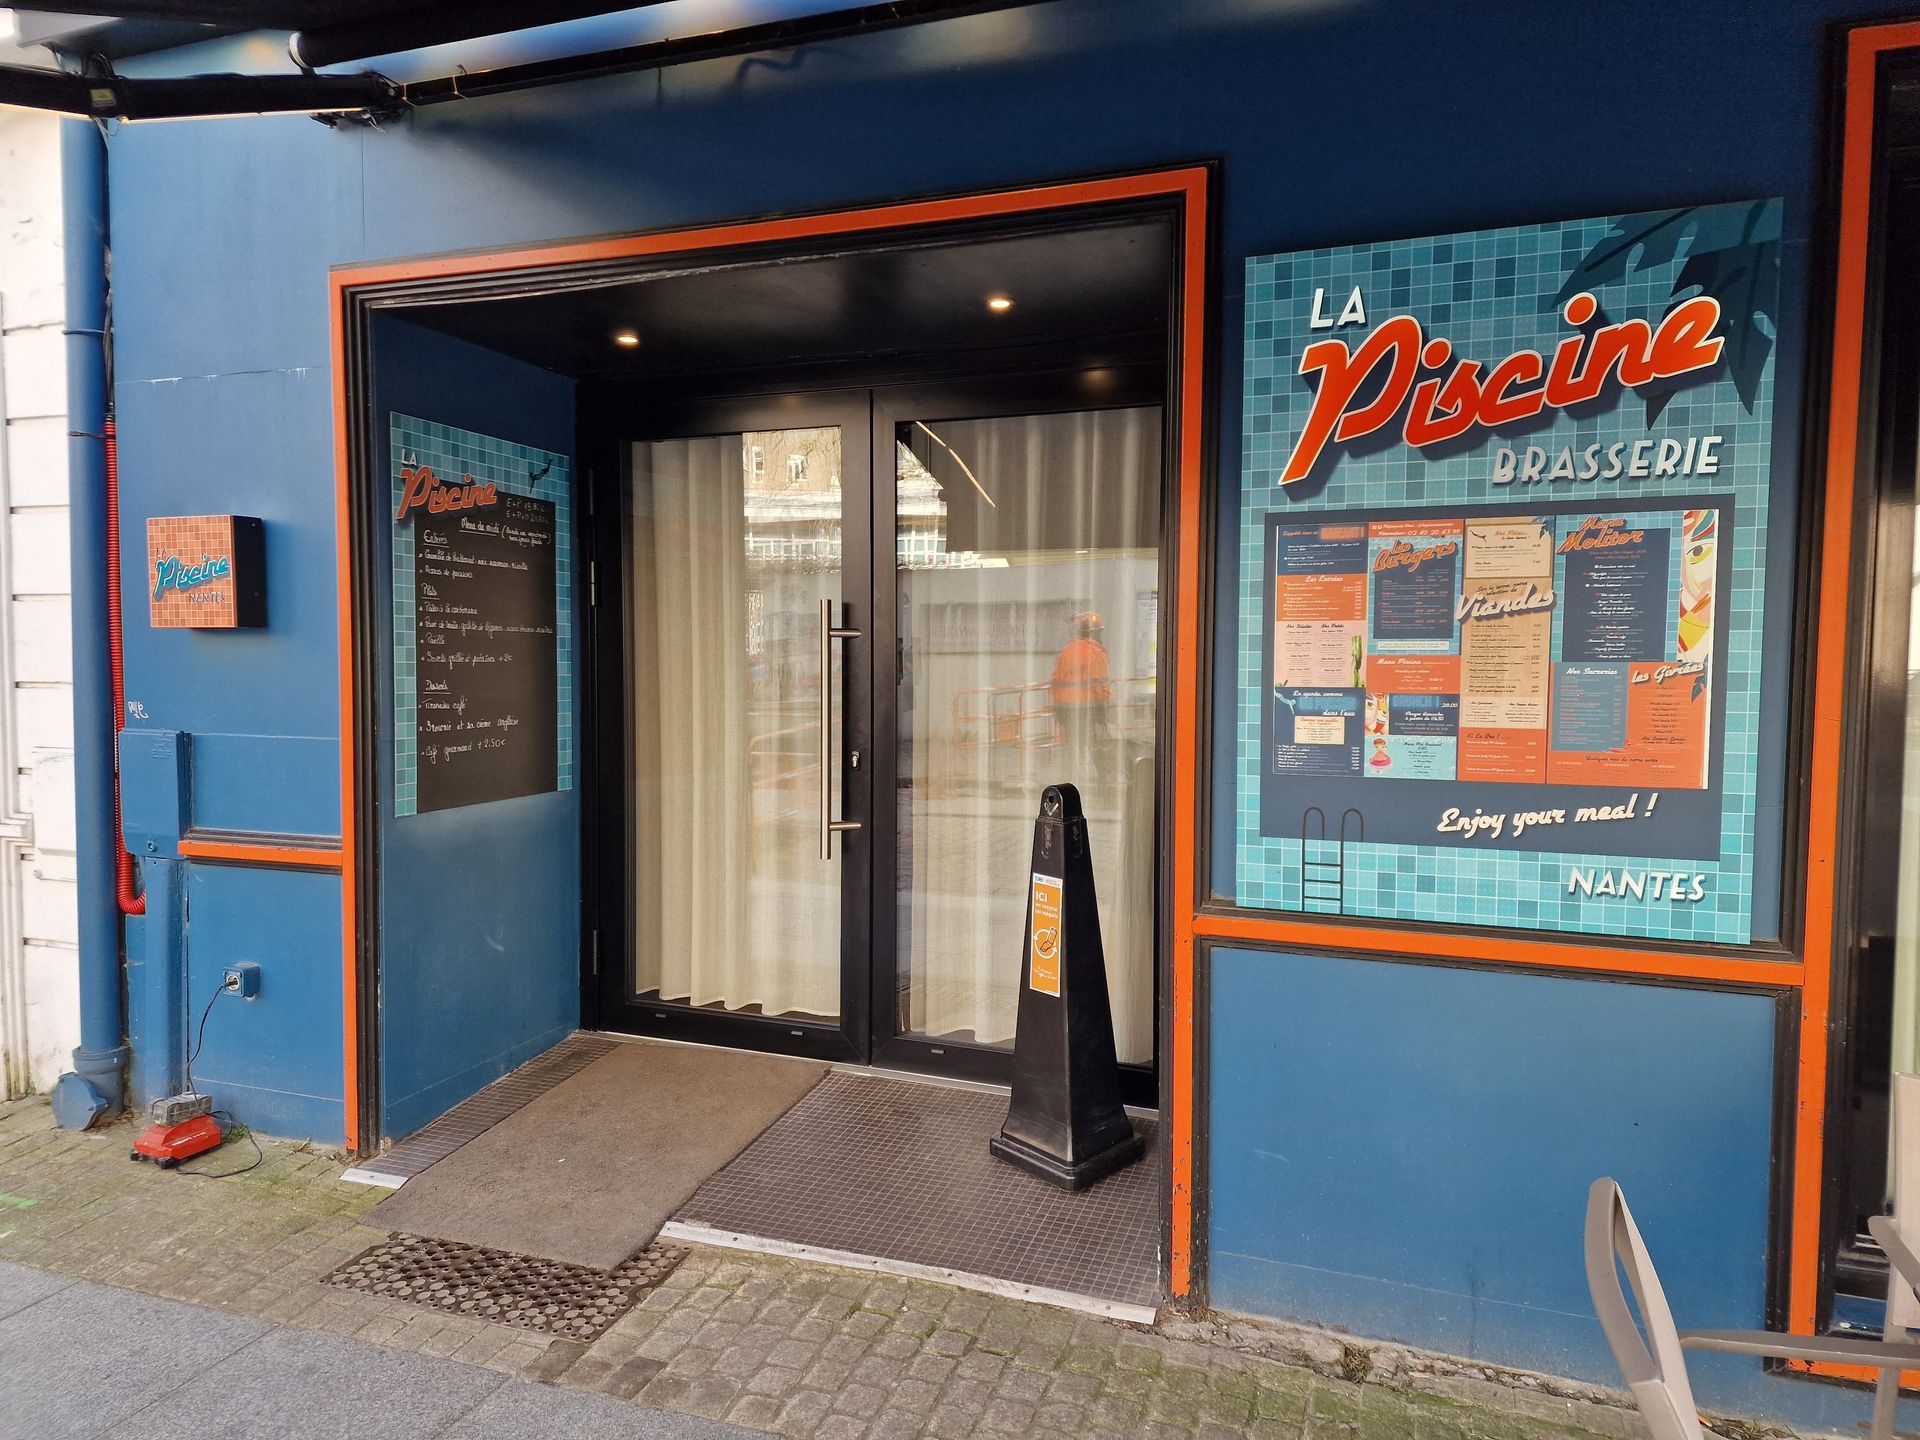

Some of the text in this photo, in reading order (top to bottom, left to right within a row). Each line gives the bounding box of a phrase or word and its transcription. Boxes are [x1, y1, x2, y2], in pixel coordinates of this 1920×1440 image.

[1310, 286, 1366, 328] LA
[1278, 292, 1725, 486] Piscine
[402, 448, 417, 466] LA
[1491, 436, 1722, 484] BRASSERIE
[396, 466, 497, 520] Piscine
[461, 516, 477, 530] Menu
[485, 522, 500, 533] midi
[1577, 516, 1624, 532] Menu
[1391, 539, 1413, 556] Les
[1557, 530, 1645, 553] Molitor
[1373, 541, 1457, 573] Burgers
[153, 553, 229, 602] Piscine
[189, 592, 225, 604] NANTES
[421, 582, 438, 596] Plats
[1456, 582, 1555, 622] Viandes
[1397, 658, 1421, 666] Piscine
[1583, 667, 1618, 676] Sucreries
[1632, 671, 1650, 684] Les
[452, 696, 466, 716] café
[1322, 708, 1339, 717] dans
[457, 720, 464, 730] et
[1437, 793, 1659, 840] Enjoy your meal !
[1567, 865, 1706, 902] NANTES
[1035, 890, 1048, 903] ICI
